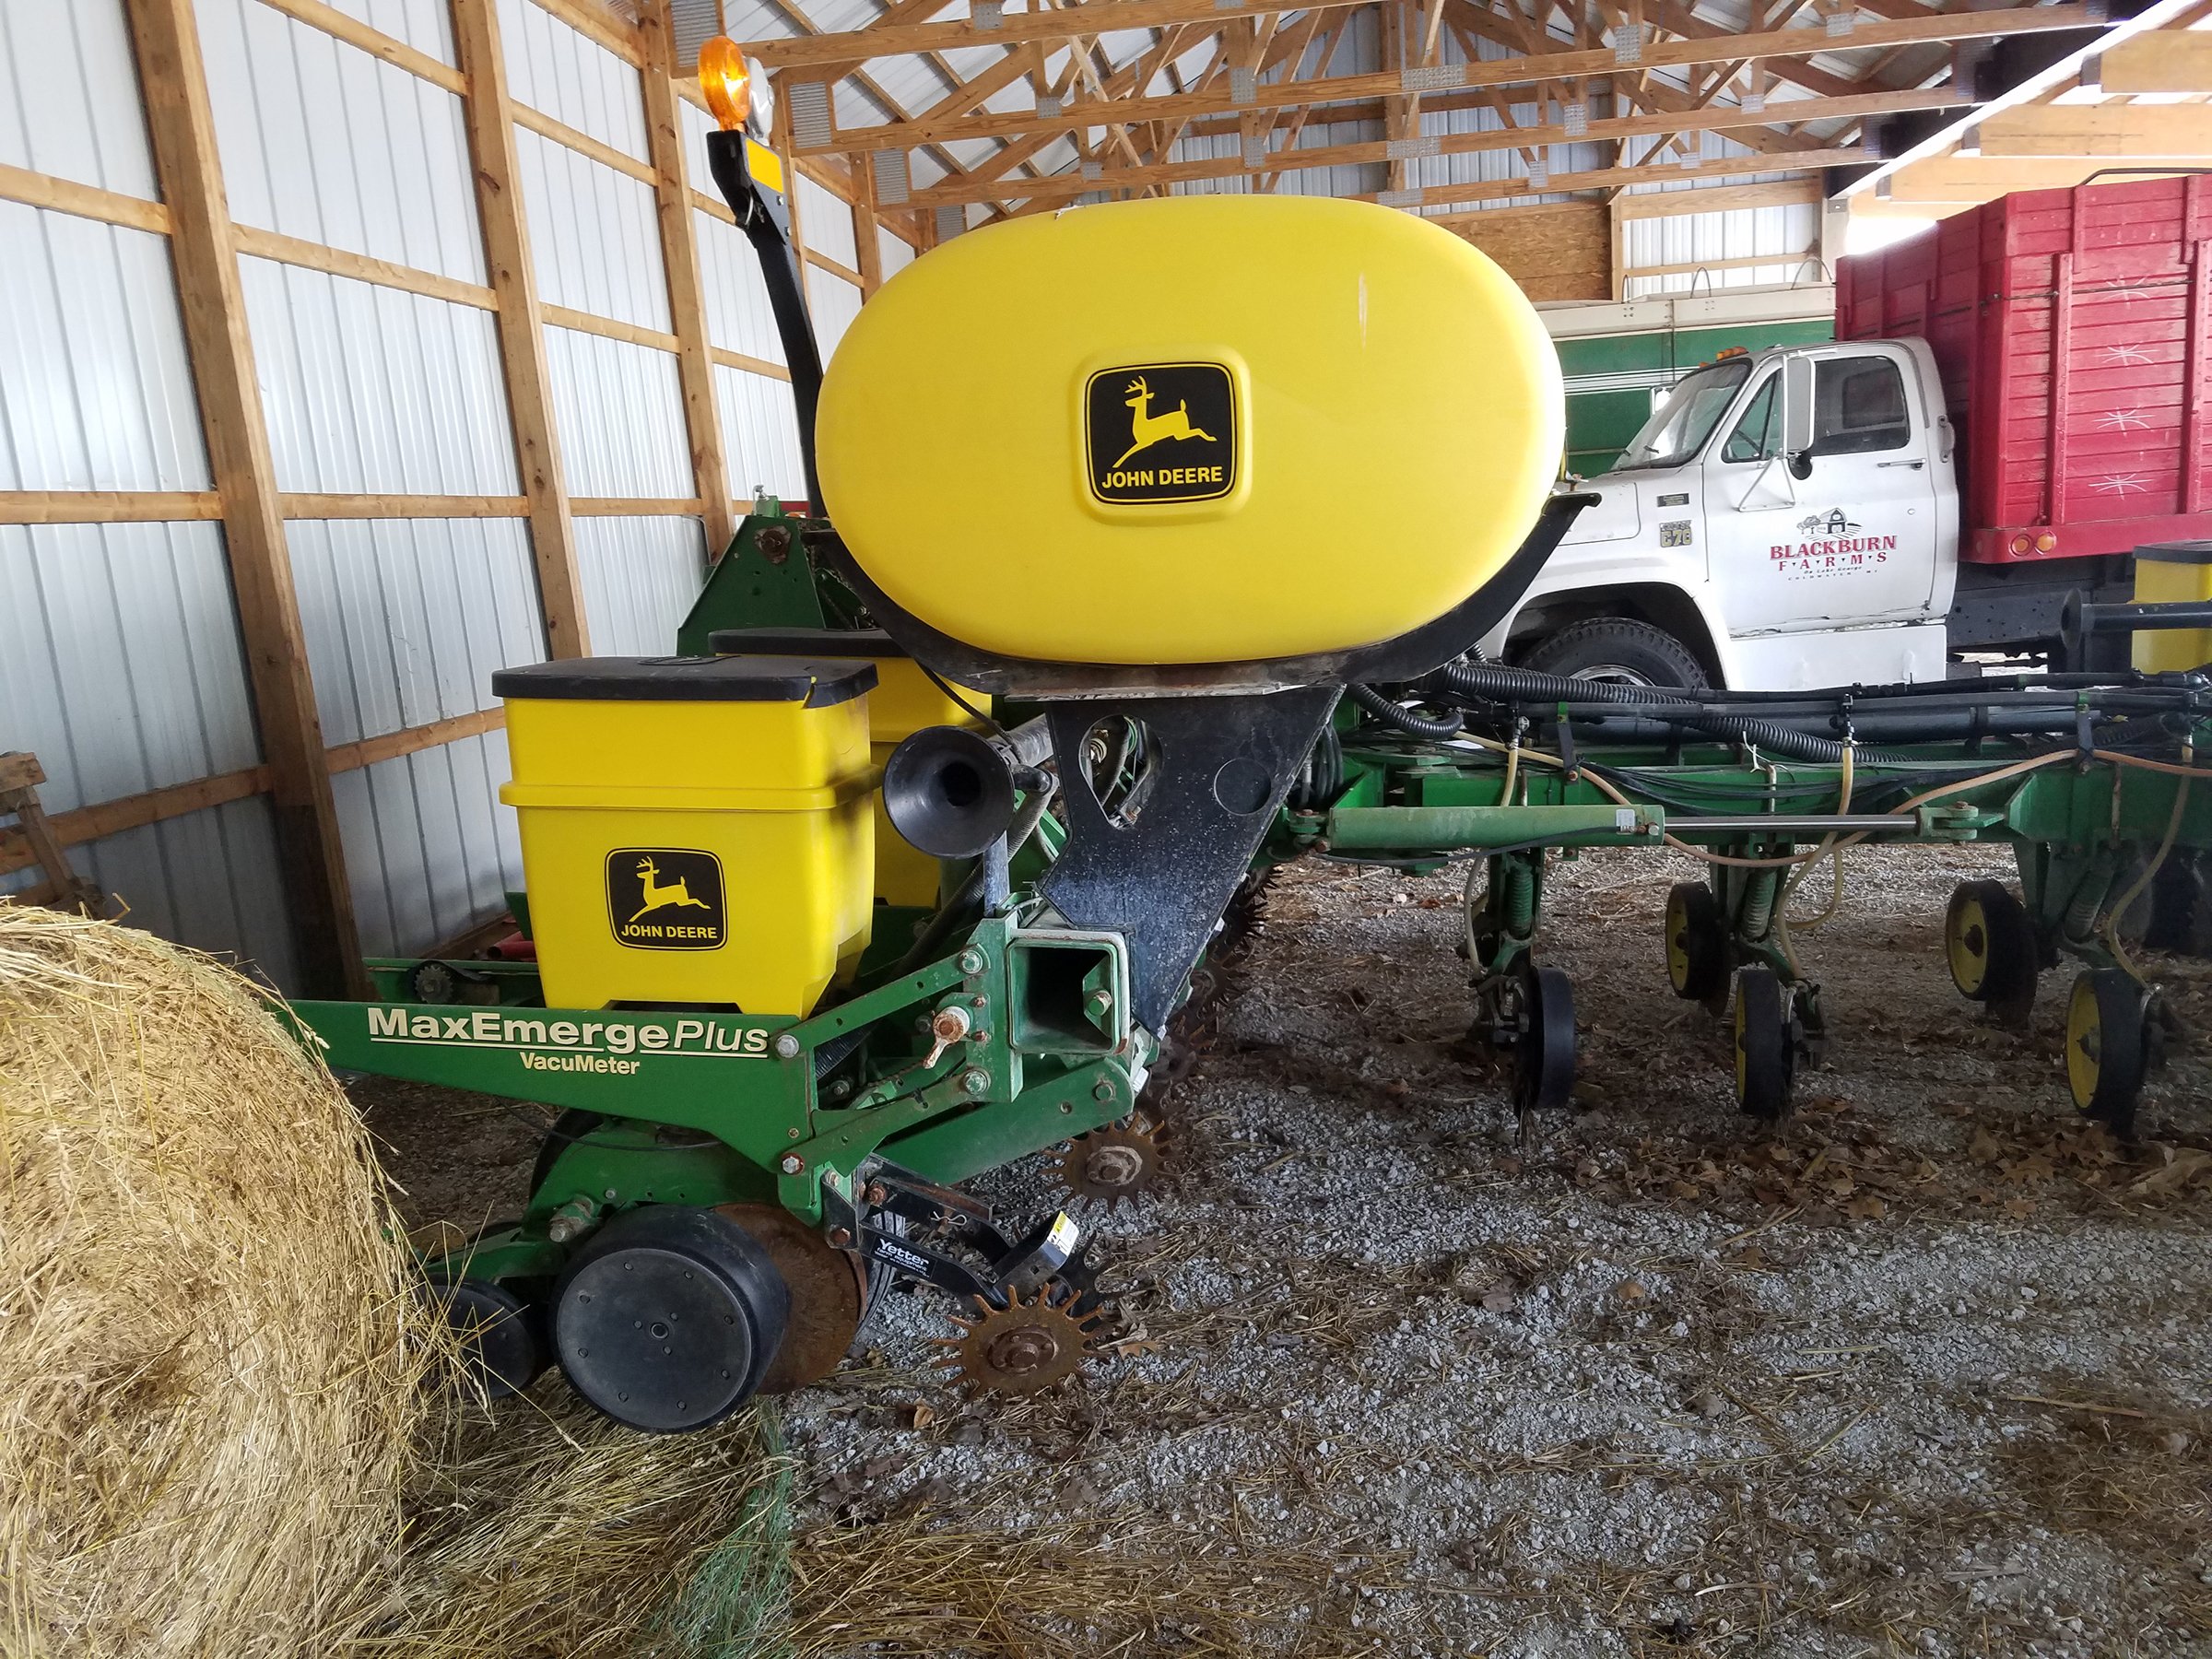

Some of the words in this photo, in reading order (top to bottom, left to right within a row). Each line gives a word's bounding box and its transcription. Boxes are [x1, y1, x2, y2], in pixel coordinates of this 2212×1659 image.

[1101, 470, 1154, 488] JOHN
[1159, 466, 1223, 485] DEERE
[1770, 535, 1897, 560] BLACKBURN
[621, 924, 663, 937] JOHN
[666, 926, 718, 938] DEERE
[519, 1052, 641, 1075] VacuMeter
[879, 1238, 930, 1265] Yetter
